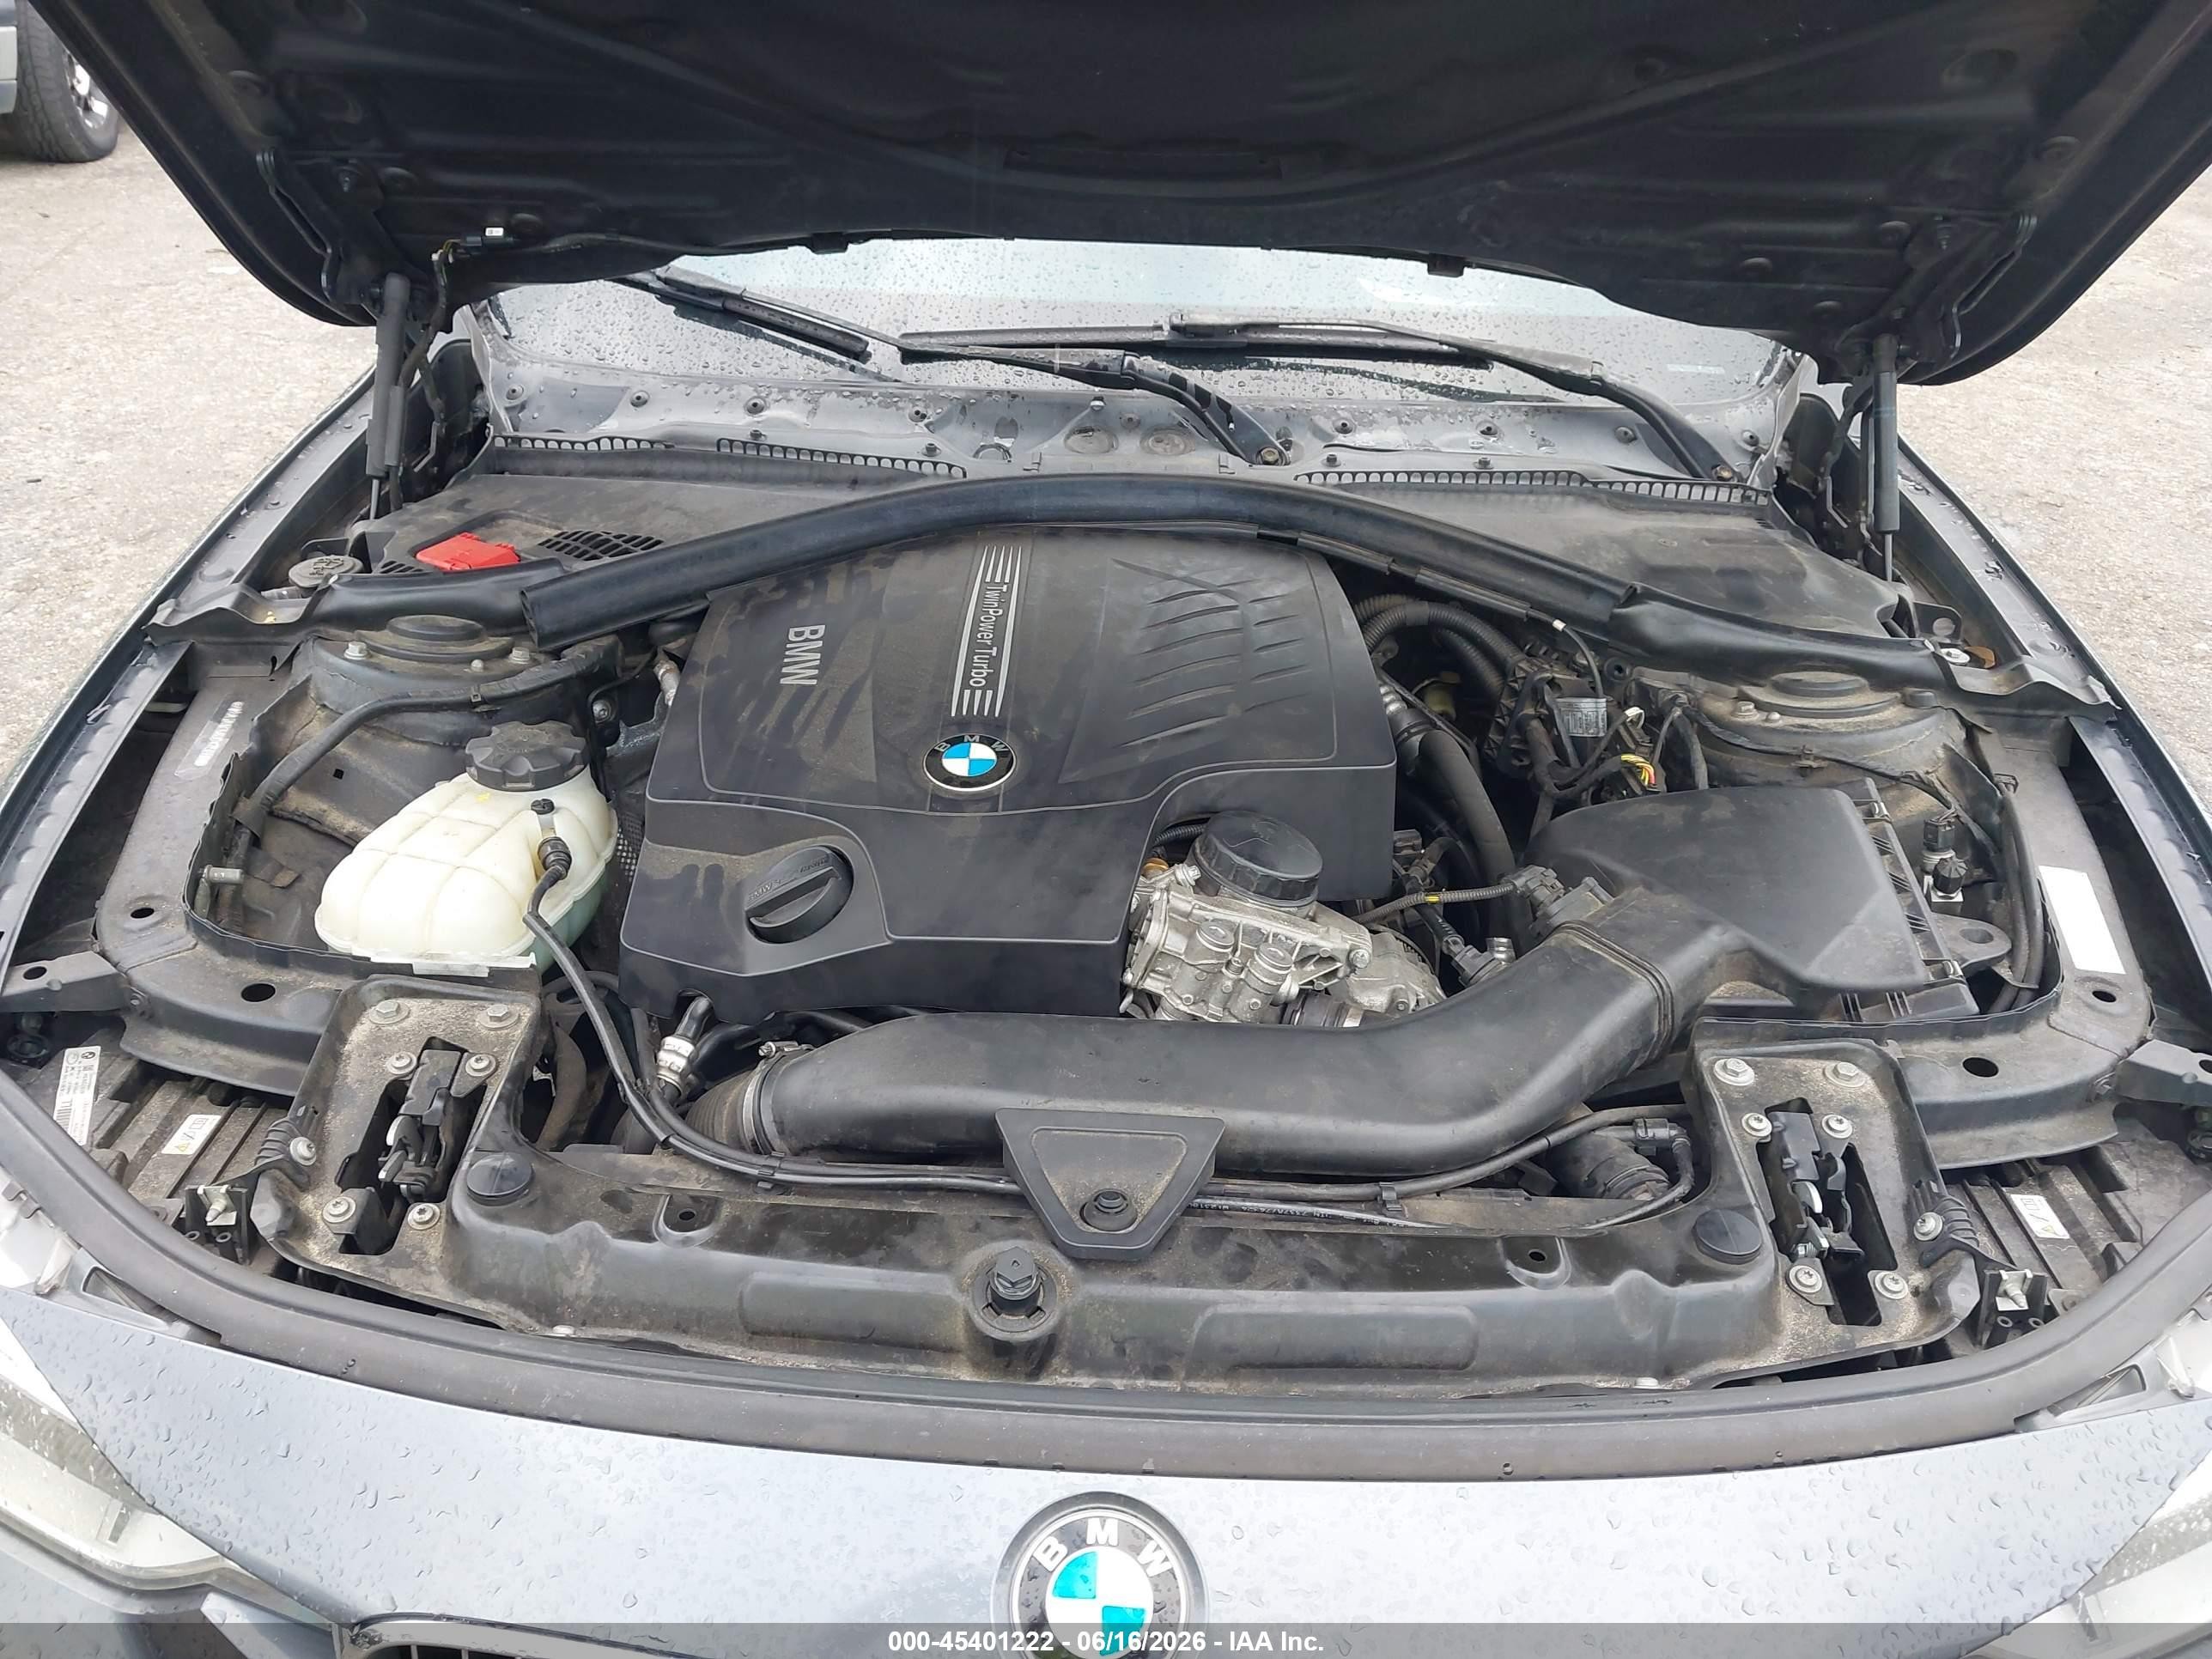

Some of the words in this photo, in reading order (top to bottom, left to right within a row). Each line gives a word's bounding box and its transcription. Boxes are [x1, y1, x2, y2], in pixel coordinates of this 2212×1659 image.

[977, 584, 1008, 646] TwinPower
[779, 624, 826, 685] BMW
[969, 646, 998, 688] Turbo
[933, 735, 1010, 752] BMW
[1032, 1517, 1174, 1577] BMW
